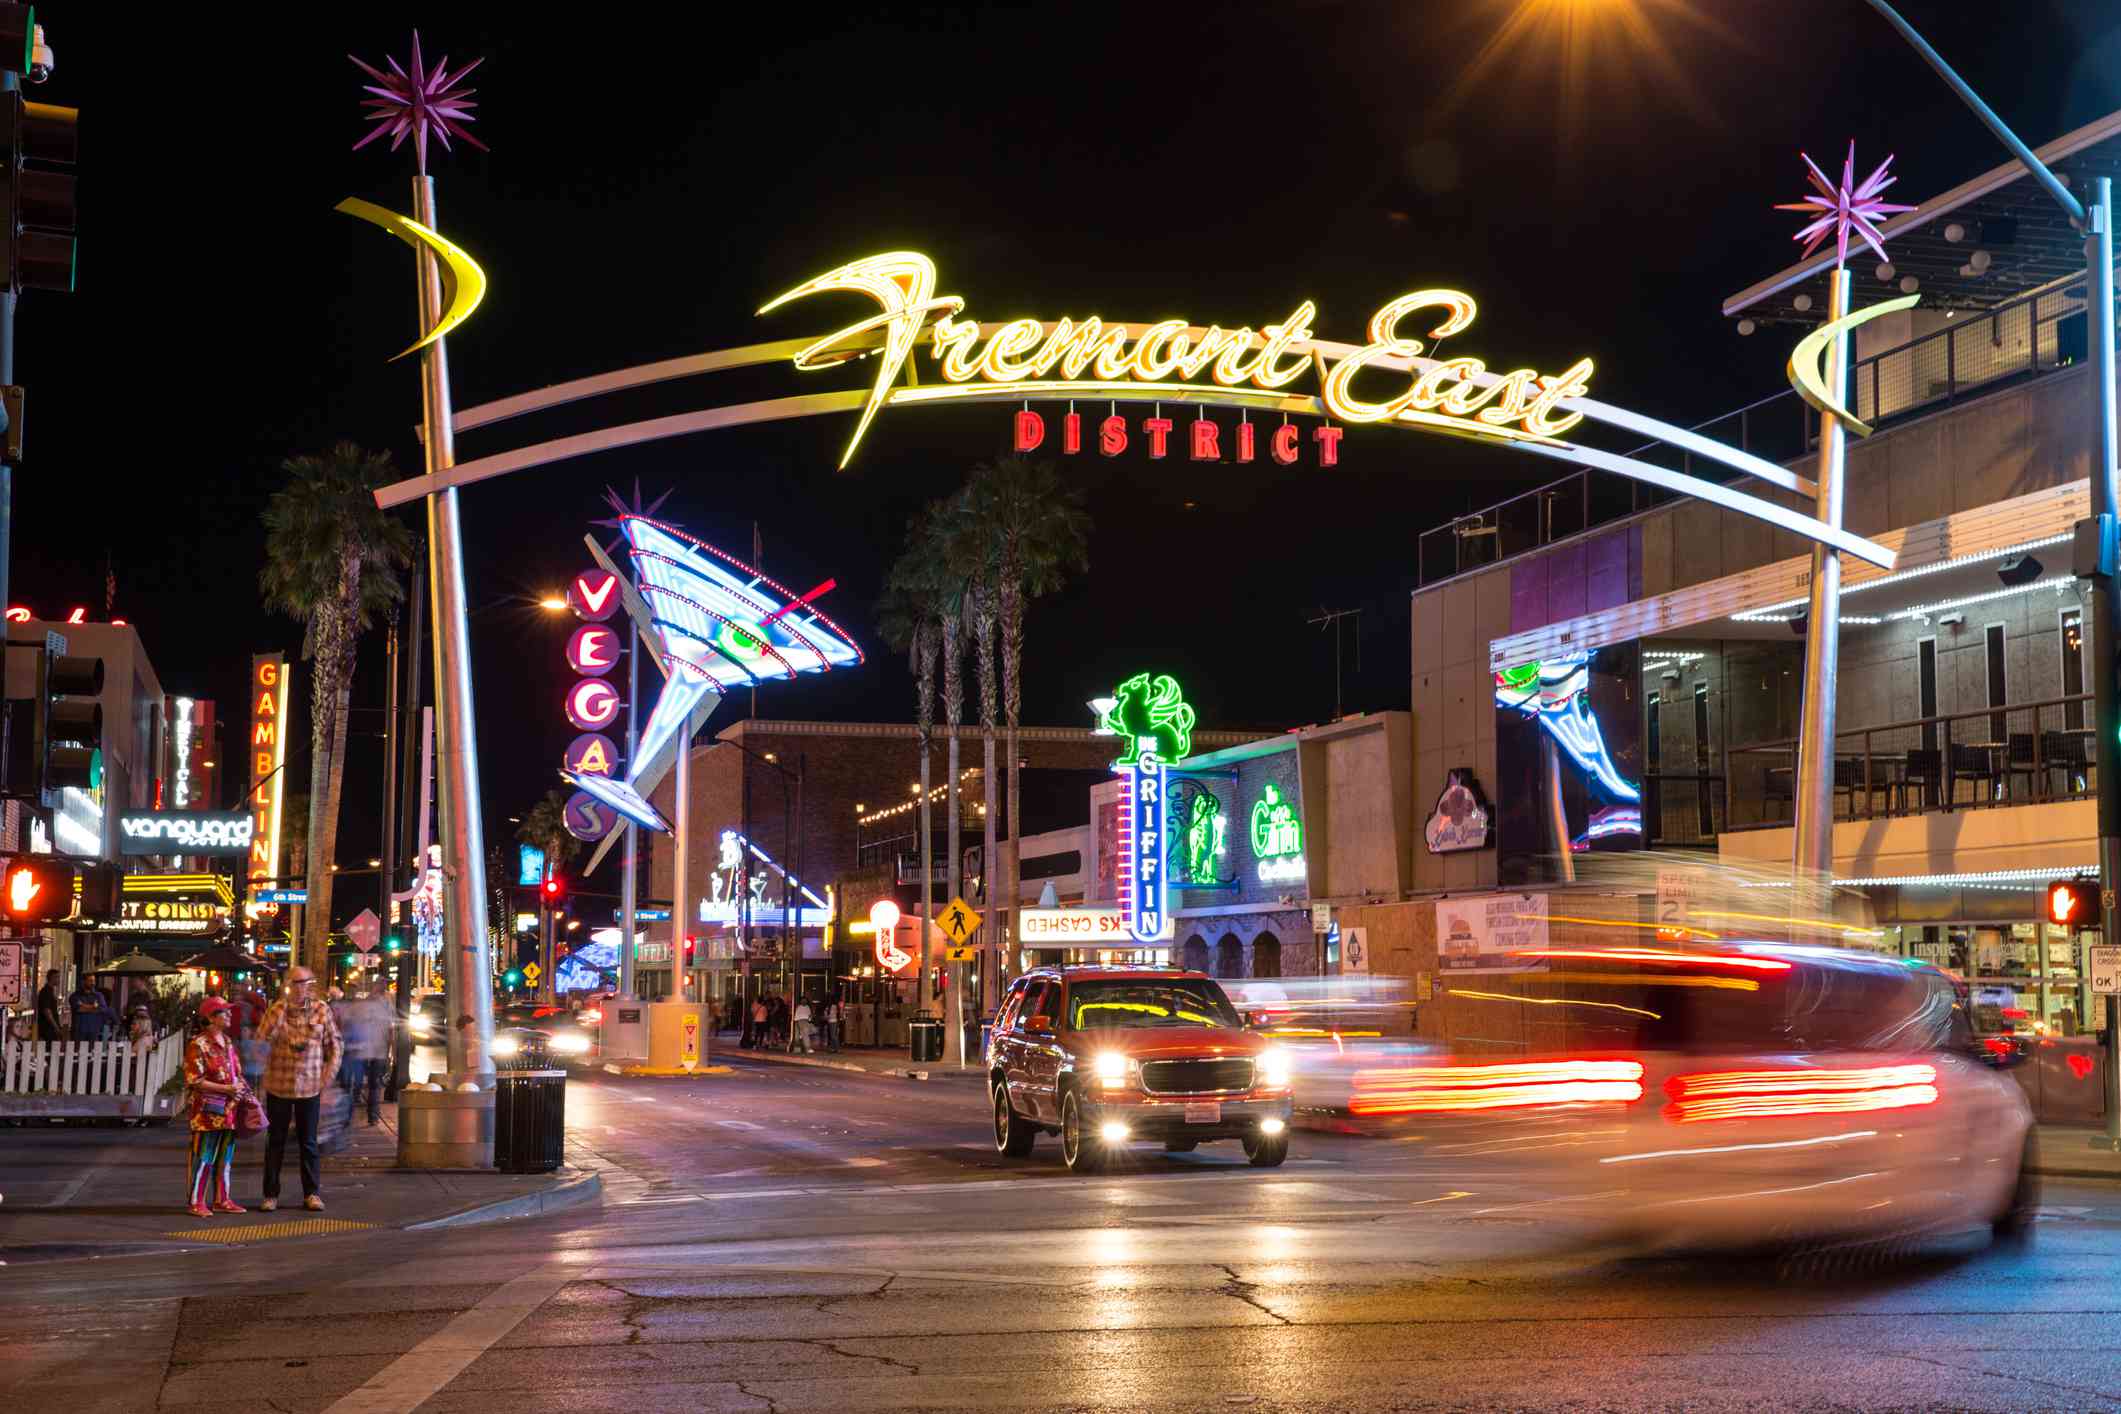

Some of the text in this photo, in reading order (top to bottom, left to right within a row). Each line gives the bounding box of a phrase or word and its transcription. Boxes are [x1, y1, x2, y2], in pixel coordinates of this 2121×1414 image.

[754, 249, 1597, 471] Fremont East
[1013, 408, 1345, 468] DISTRICT
[574, 575, 620, 836] VEGAS
[251, 662, 276, 890] GAMBLING
[121, 815, 254, 842] vanguard
[1138, 751, 1166, 934] GRIFFIN
[144, 902, 216, 919] COIN(S)
[1026, 916, 1092, 932] CASHED
[1914, 937, 1957, 958] inspire
[2096, 976, 2112, 987] OK
